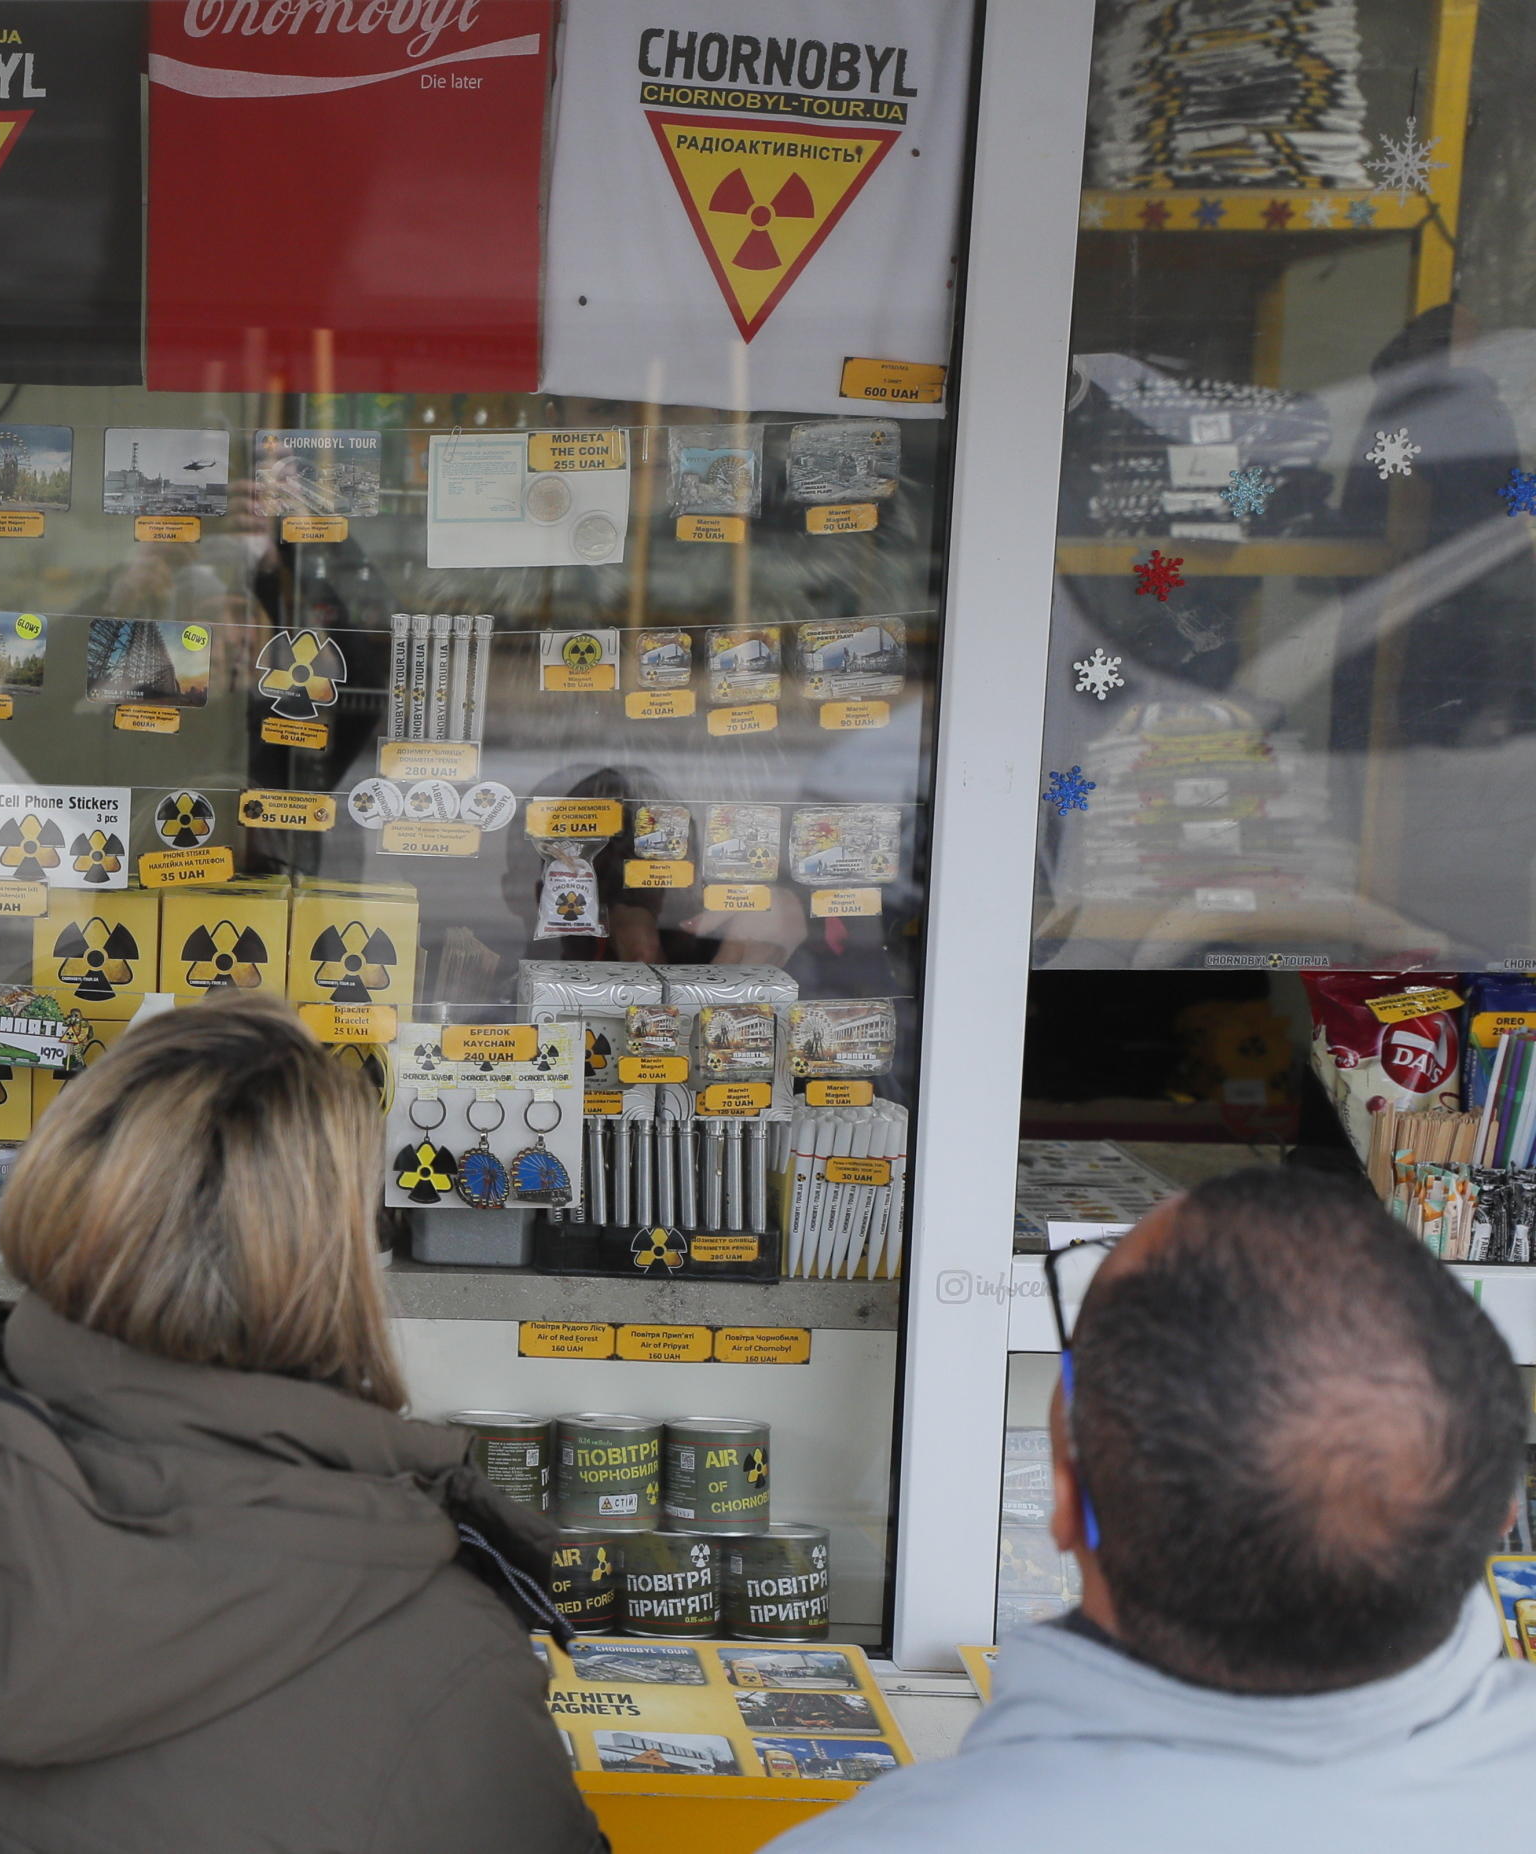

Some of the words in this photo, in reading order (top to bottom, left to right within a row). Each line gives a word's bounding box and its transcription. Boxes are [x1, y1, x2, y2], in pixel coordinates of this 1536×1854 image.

[638, 27, 917, 98] CHORNOBYL
[421, 74, 446, 89] Die
[451, 74, 483, 90] later
[643, 85, 904, 120] CHORNOBYL-TOUR.UA
[676, 134, 862, 163] РАДІОАКТИВНІСТЬ!
[864, 386, 886, 397] 600
[891, 387, 919, 399] UAH
[283, 437, 344, 449] CHORNOBYL
[349, 438, 376, 449] TOUR
[552, 432, 604, 444] МОНЕТА
[550, 445, 574, 457] THE
[578, 445, 609, 457] COIN
[554, 458, 576, 470] 255
[579, 458, 605, 470] UAH
[17, 618, 40, 634] GLOWS
[184, 631, 206, 645] GLOWS
[405, 767, 427, 777] 280
[431, 768, 457, 777] UAH
[25, 795, 64, 809] Phone
[68, 796, 119, 810] Stickers
[262, 813, 276, 824] 95
[280, 814, 306, 825] UAH
[552, 824, 566, 834] 45
[571, 823, 597, 833] UAH
[402, 842, 417, 852] 20
[421, 843, 448, 853] UAH
[161, 872, 174, 882] 35
[178, 870, 205, 881] UAH
[1206, 955, 1265, 966] CHORNOBYL
[1284, 955, 1329, 966] TOUR.UA
[334, 1005, 370, 1015] Браслет
[334, 1016, 369, 1025] Bracelet
[334, 1027, 344, 1036] 25
[346, 1027, 369, 1036] UAH
[470, 1028, 511, 1037] БРЕЛОК
[464, 1040, 515, 1048] KAYCHAIN
[41, 1047, 64, 1059] 1970
[464, 1051, 484, 1061] 240
[490, 1052, 514, 1061] UAH
[559, 1334, 573, 1342] Red
[575, 1335, 598, 1343] Forest
[663, 1341, 689, 1350] Pripyat
[732, 1344, 743, 1352] Air
[744, 1344, 752, 1352] of
[753, 1344, 792, 1353] Chornobyl
[663, 1352, 681, 1360] UAH
[577, 1440, 659, 1466] ПОВІТРЯ
[705, 1450, 739, 1468] AIR
[580, 1461, 659, 1483] ЧОРНОБИЛЯ
[708, 1481, 729, 1493] OF
[552, 1549, 582, 1567] AIR
[627, 1568, 712, 1592] ПОВІТРЯ
[747, 1571, 828, 1597] ПОВІТРЯ
[553, 1581, 571, 1592] OF
[629, 1592, 713, 1617] ПРИП'ЯТІ
[595, 1645, 655, 1654] CHORNOBYL
